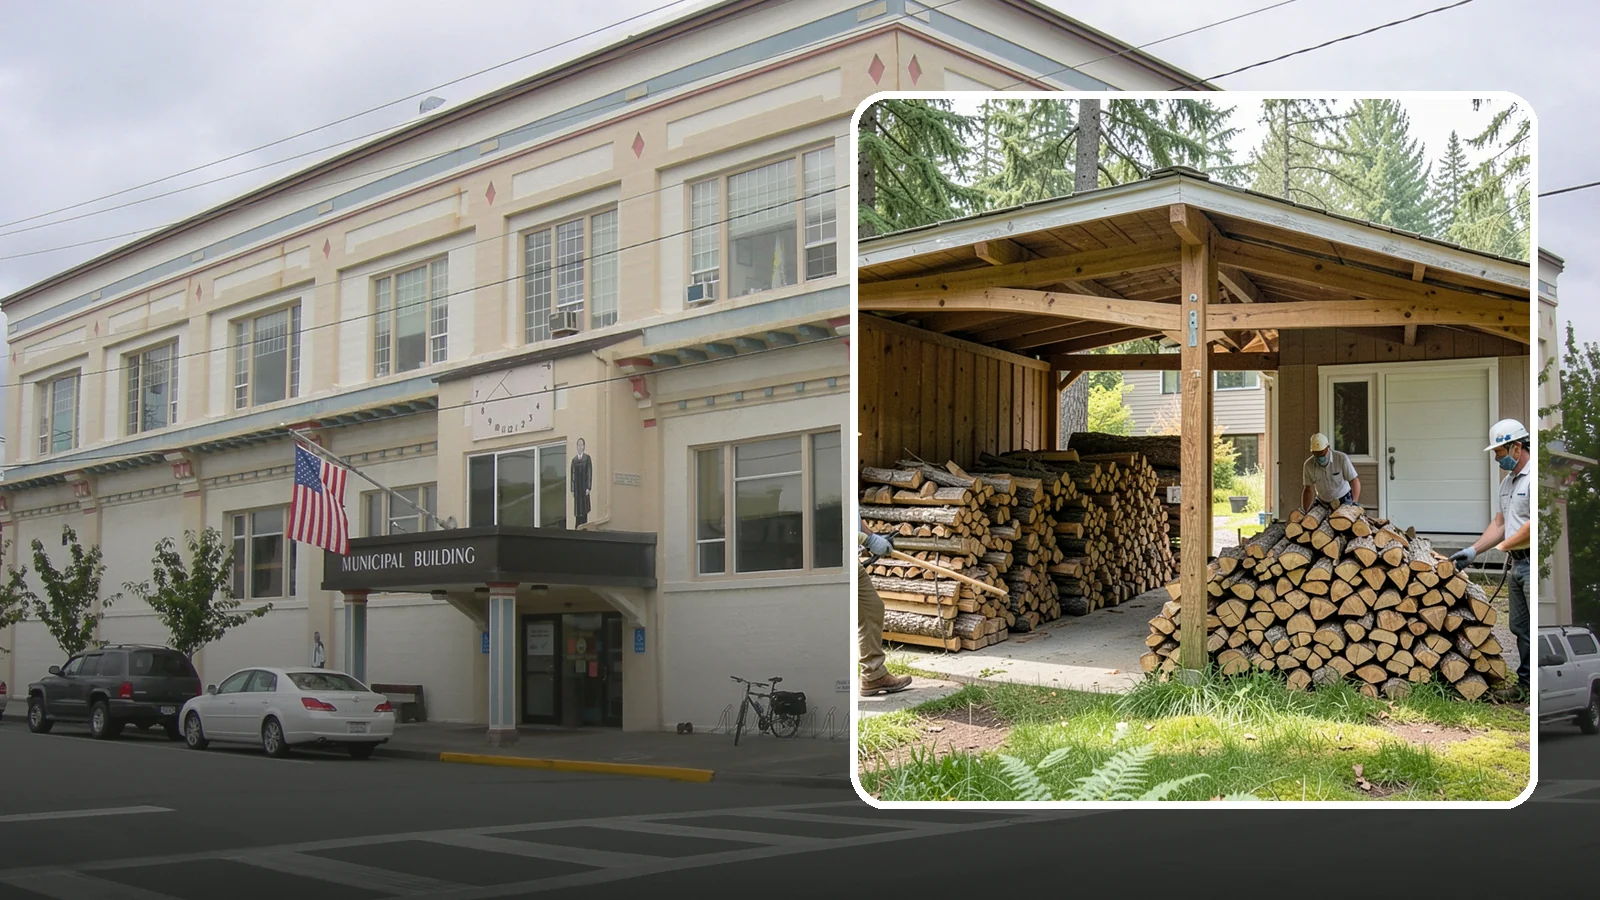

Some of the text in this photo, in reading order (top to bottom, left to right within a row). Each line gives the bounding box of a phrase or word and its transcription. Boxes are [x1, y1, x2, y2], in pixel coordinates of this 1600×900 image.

[480, 406, 485, 415] 8
[487, 417, 492, 426] 9
[529, 413, 533, 422] 3
[494, 423, 500, 432] 10
[521, 420, 526, 428] 2
[507, 425, 513, 433] 12
[341, 546, 475, 572] MUNICIPAL BUILDING
